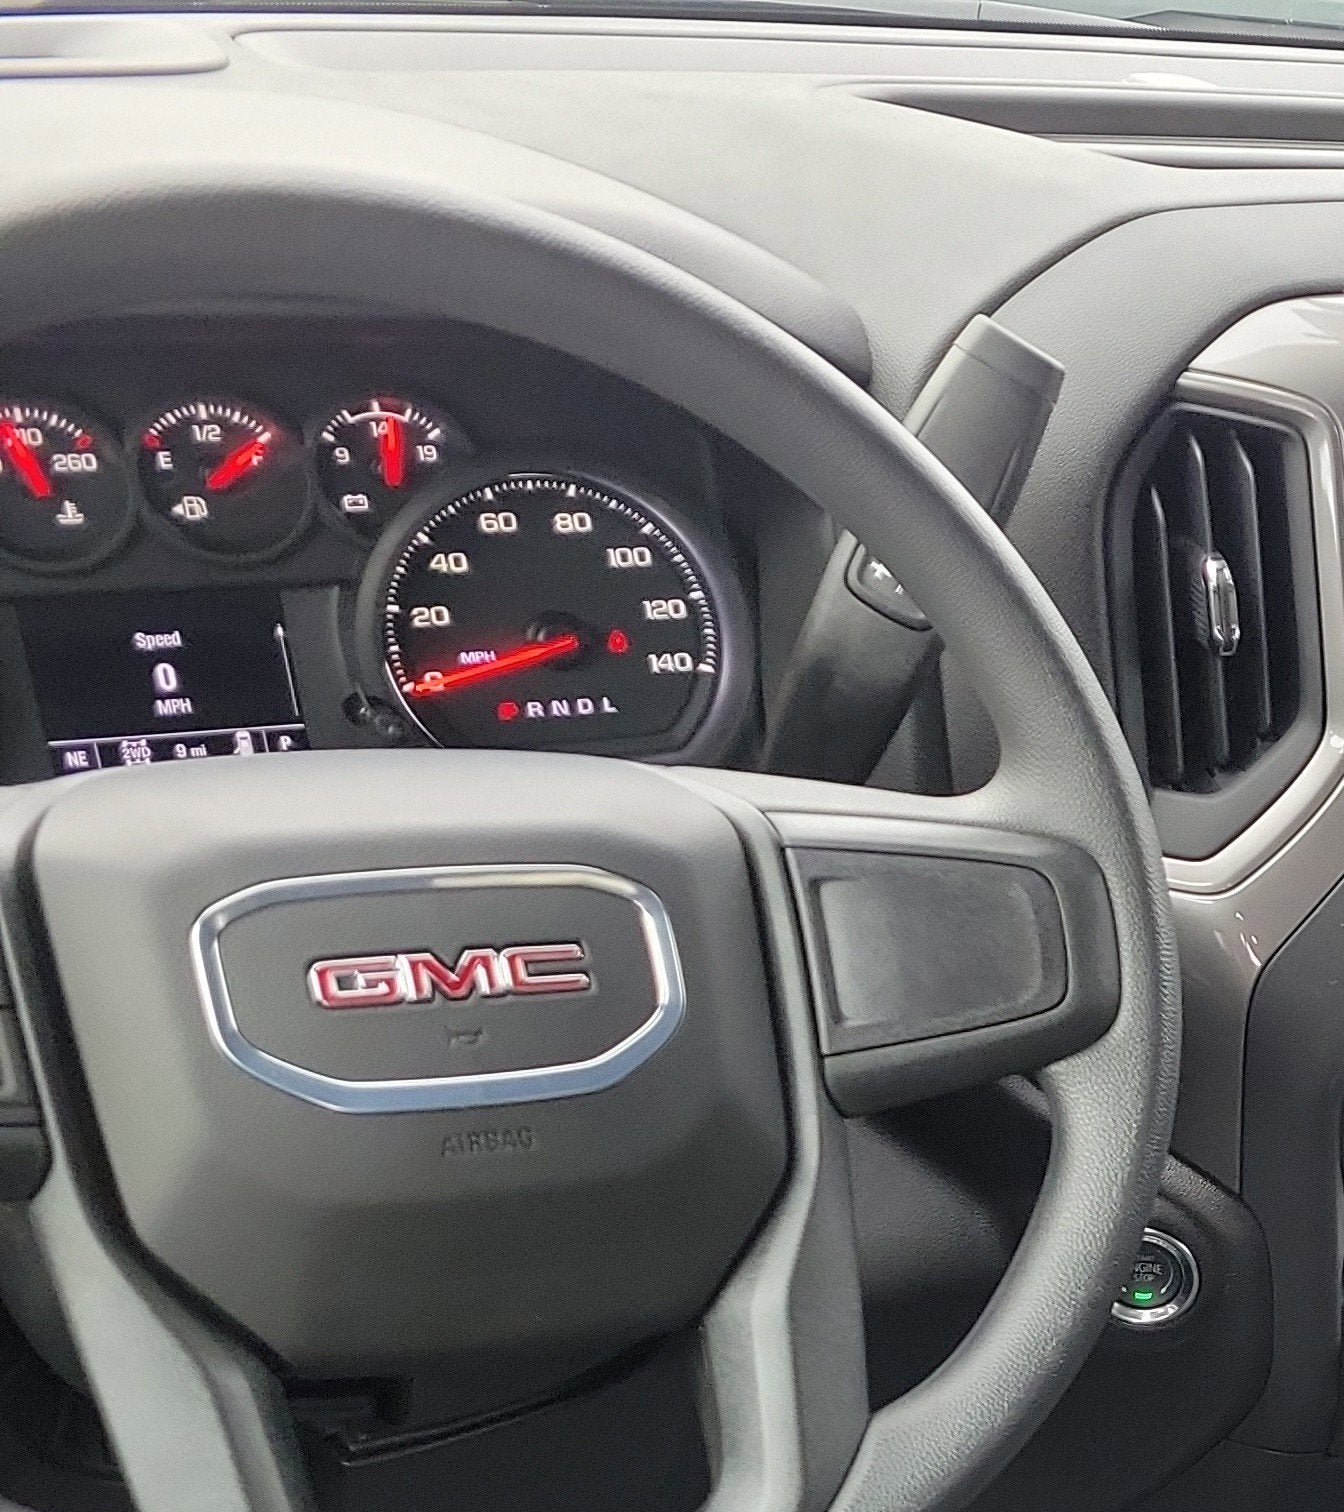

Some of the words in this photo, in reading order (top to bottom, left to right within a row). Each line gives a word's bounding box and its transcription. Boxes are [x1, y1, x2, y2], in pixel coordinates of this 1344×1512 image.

[191, 424, 222, 442] 1/2
[52, 453, 97, 472] 260
[156, 451, 173, 471] E
[334, 446, 350, 465] 9
[416, 445, 437, 462] 19
[479, 512, 517, 532] 60
[554, 512, 592, 532] 80
[429, 552, 468, 573] 40
[607, 547, 651, 567] 100
[410, 606, 450, 626] 20
[643, 599, 687, 620] 120
[133, 630, 182, 651] Speed
[458, 650, 496, 665] MPH
[648, 652, 693, 673] 140
[152, 662, 178, 693] 0
[154, 697, 193, 717] MPH
[526, 701, 545, 717] R
[550, 699, 571, 716] N
[576, 698, 594, 715] D
[602, 696, 619, 713] L
[121, 745, 151, 759] 2WD
[175, 744, 186, 759] 9
[190, 744, 207, 758] mi
[280, 736, 291, 750] P
[64, 750, 88, 768] NE
[309, 943, 591, 1009] GMC
